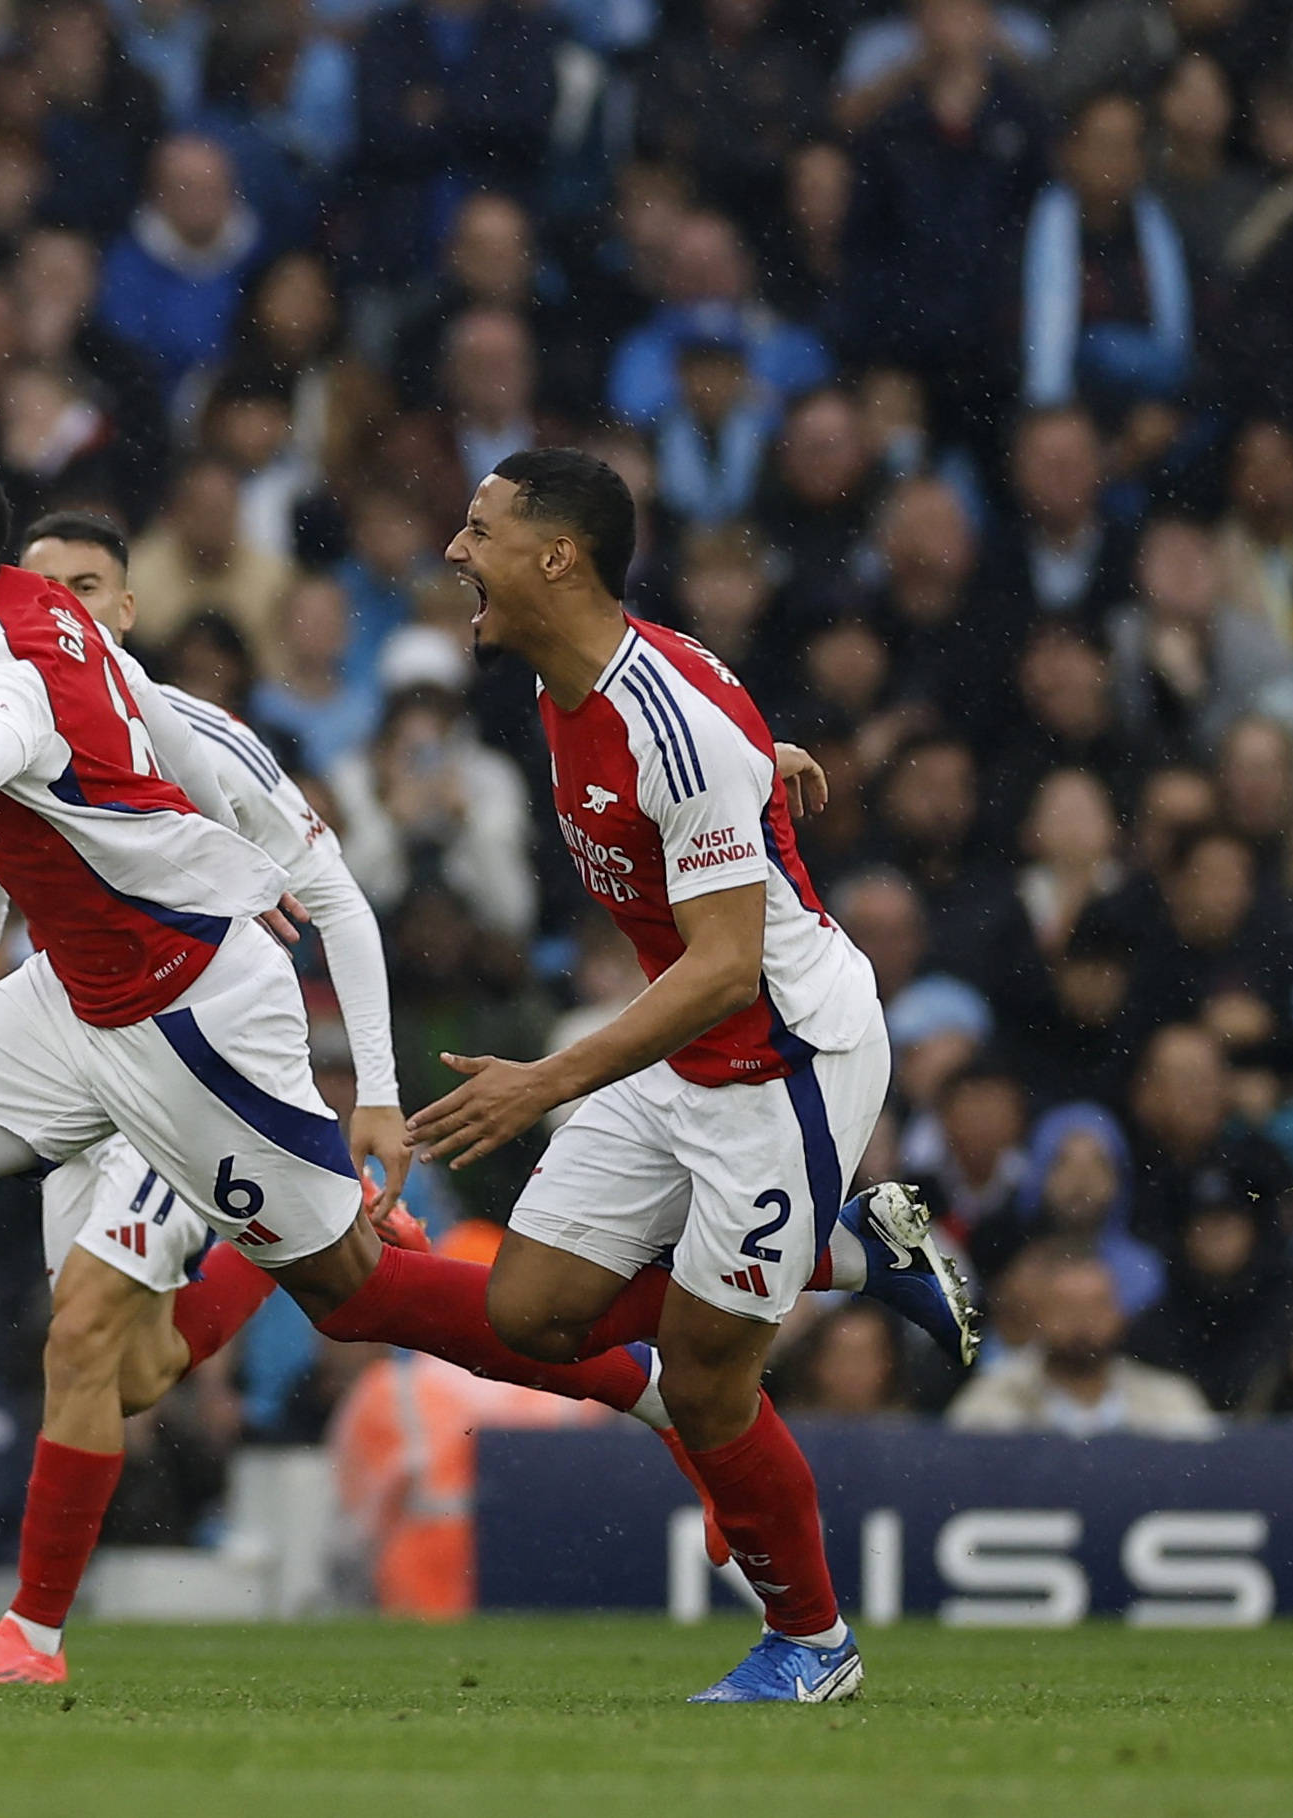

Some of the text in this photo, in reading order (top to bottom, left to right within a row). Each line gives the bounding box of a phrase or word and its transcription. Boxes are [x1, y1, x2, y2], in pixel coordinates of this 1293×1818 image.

[676, 841, 758, 874] RWANDA
[691, 826, 735, 850] VISIT
[129, 1167, 176, 1226] 11
[214, 1154, 265, 1219] 6
[740, 1188, 791, 1263] 2
[729, 1547, 772, 1567] FC
